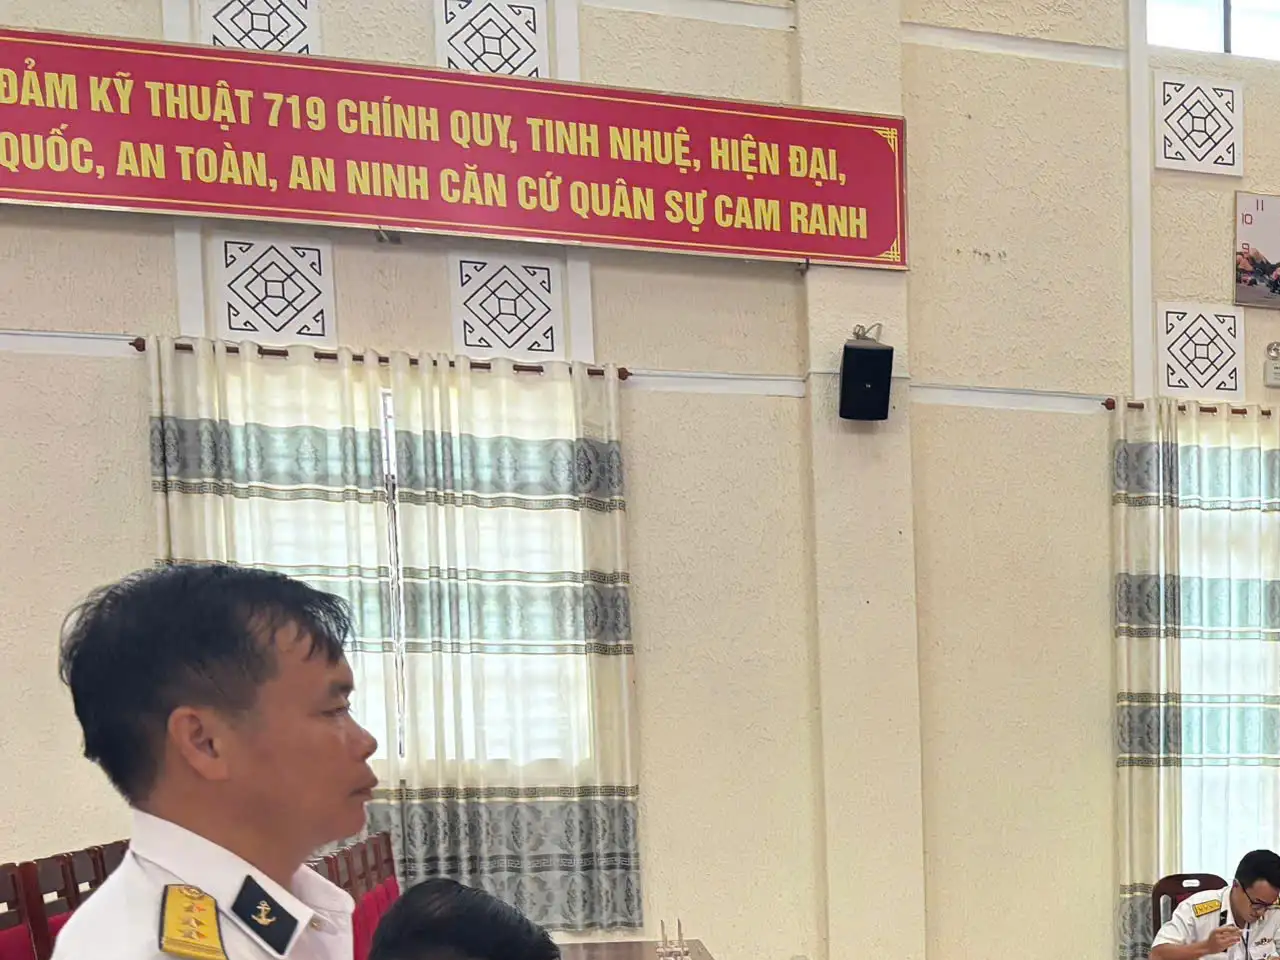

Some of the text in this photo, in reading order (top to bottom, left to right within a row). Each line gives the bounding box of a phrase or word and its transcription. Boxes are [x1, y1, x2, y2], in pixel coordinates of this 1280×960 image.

[0, 57, 847, 187] ĐẢM KỸ THUẬT 719 CHÍNH QUY, TINH NHUỆ, HIỆN ĐẠI,
[0, 123, 868, 240] QUỐC, AN TOÀN, AN NINH CĂN CỨ QUÂN SỰ CAM RANH
[1256, 199, 1264, 212] 11
[1242, 213, 1253, 225] 10
